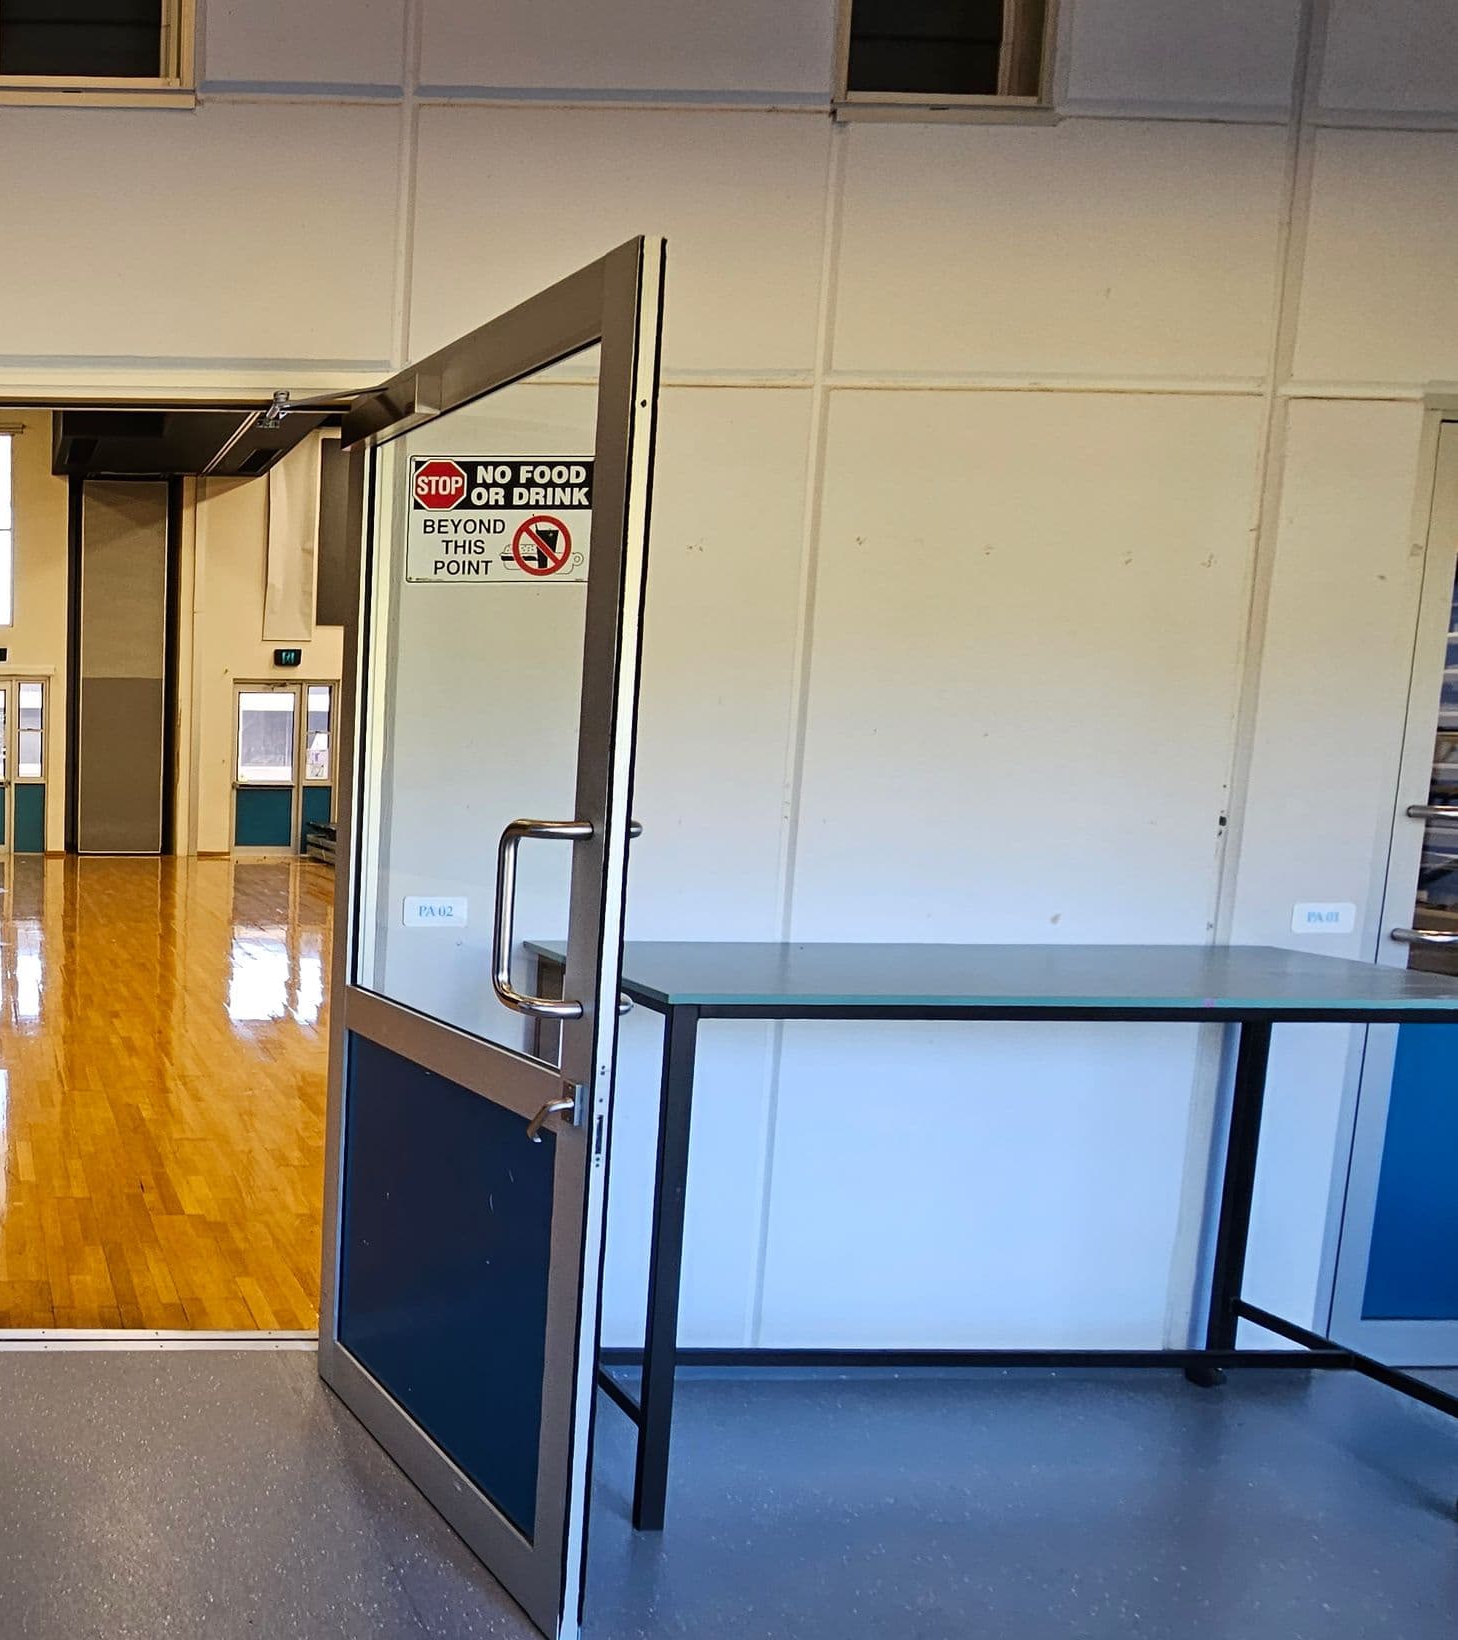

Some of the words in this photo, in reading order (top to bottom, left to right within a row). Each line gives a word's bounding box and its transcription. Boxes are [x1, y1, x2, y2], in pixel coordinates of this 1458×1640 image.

[476, 465, 512, 484] NO
[519, 465, 587, 484] FOOD
[416, 476, 463, 496] STOP
[470, 487, 506, 506] OR
[512, 487, 589, 506] DRINK
[423, 519, 506, 535] BEYOND
[441, 539, 485, 555] THIS
[433, 560, 493, 576] POINT
[419, 905, 435, 917] PA
[438, 905, 454, 917] 02
[1307, 911, 1323, 923] PA
